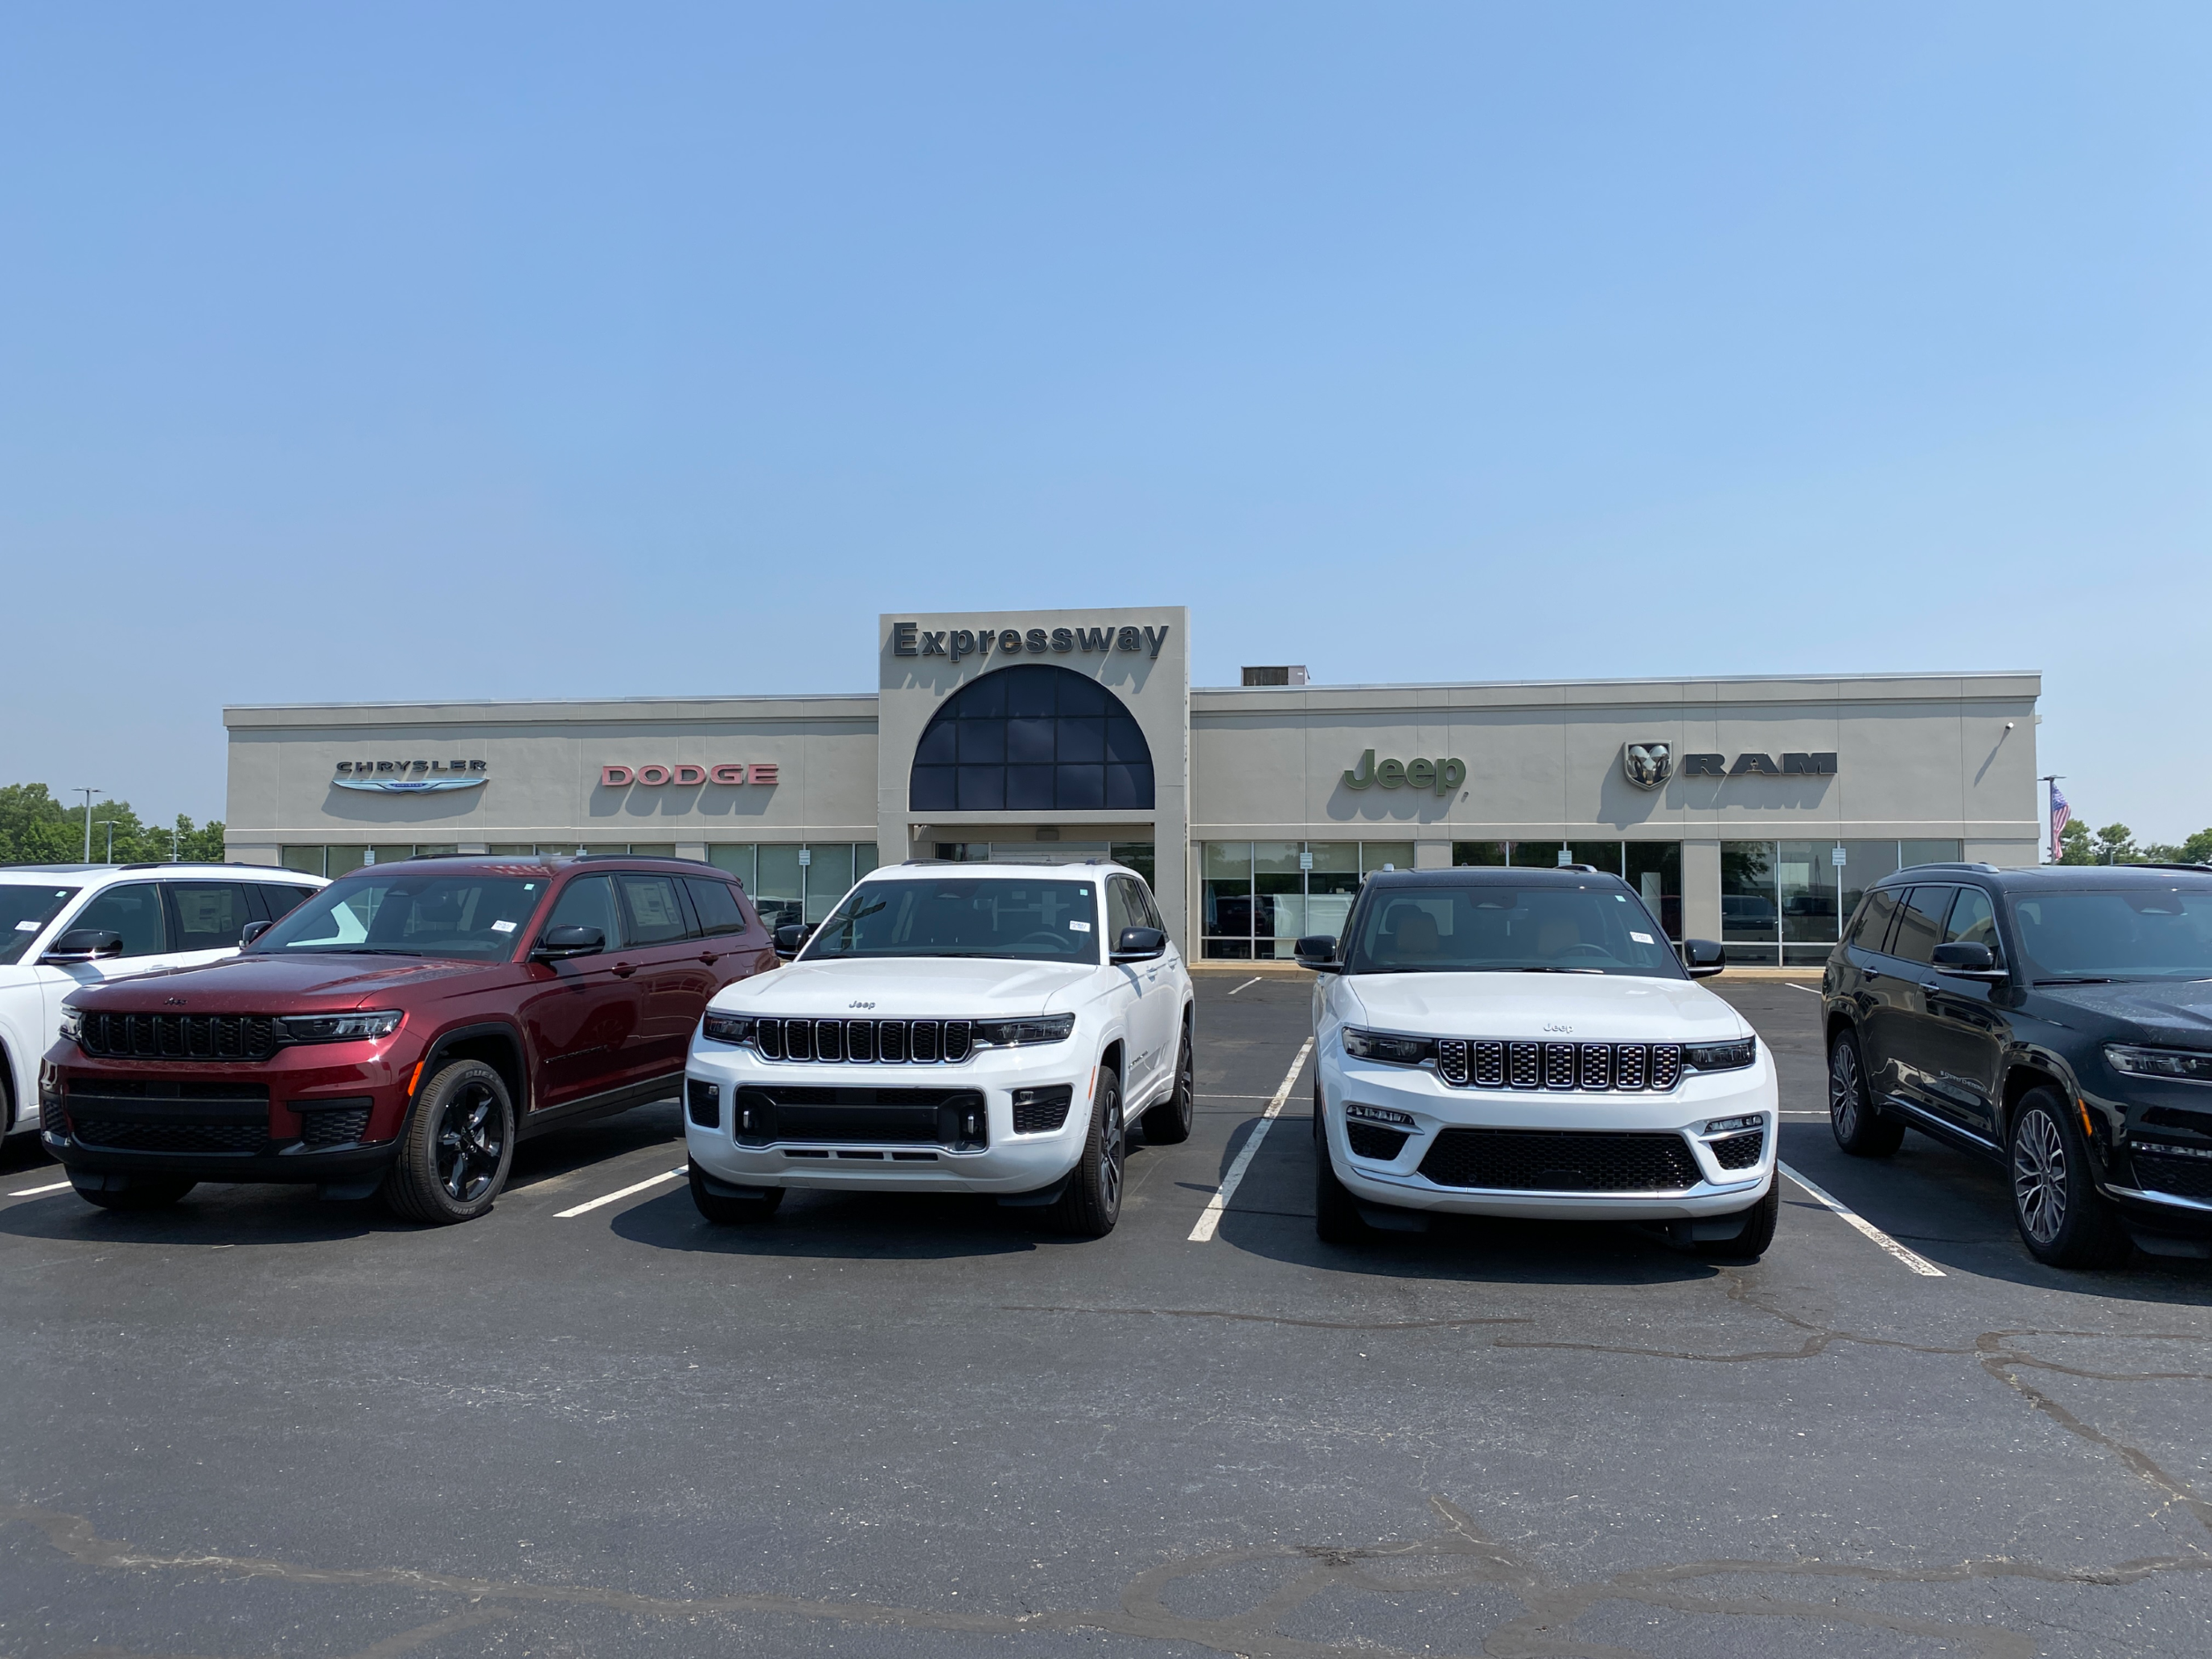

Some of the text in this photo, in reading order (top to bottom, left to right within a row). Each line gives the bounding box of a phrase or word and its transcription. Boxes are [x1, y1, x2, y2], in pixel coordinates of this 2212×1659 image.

[892, 622, 1170, 662] Expressway
[336, 760, 487, 772] CHRYSLER
[1344, 749, 1466, 796] Jeep
[1684, 752, 1838, 775] RAM
[602, 764, 779, 786] DODGE
[849, 1000, 876, 1010] Jeep
[1543, 1023, 1574, 1034] Jeep
